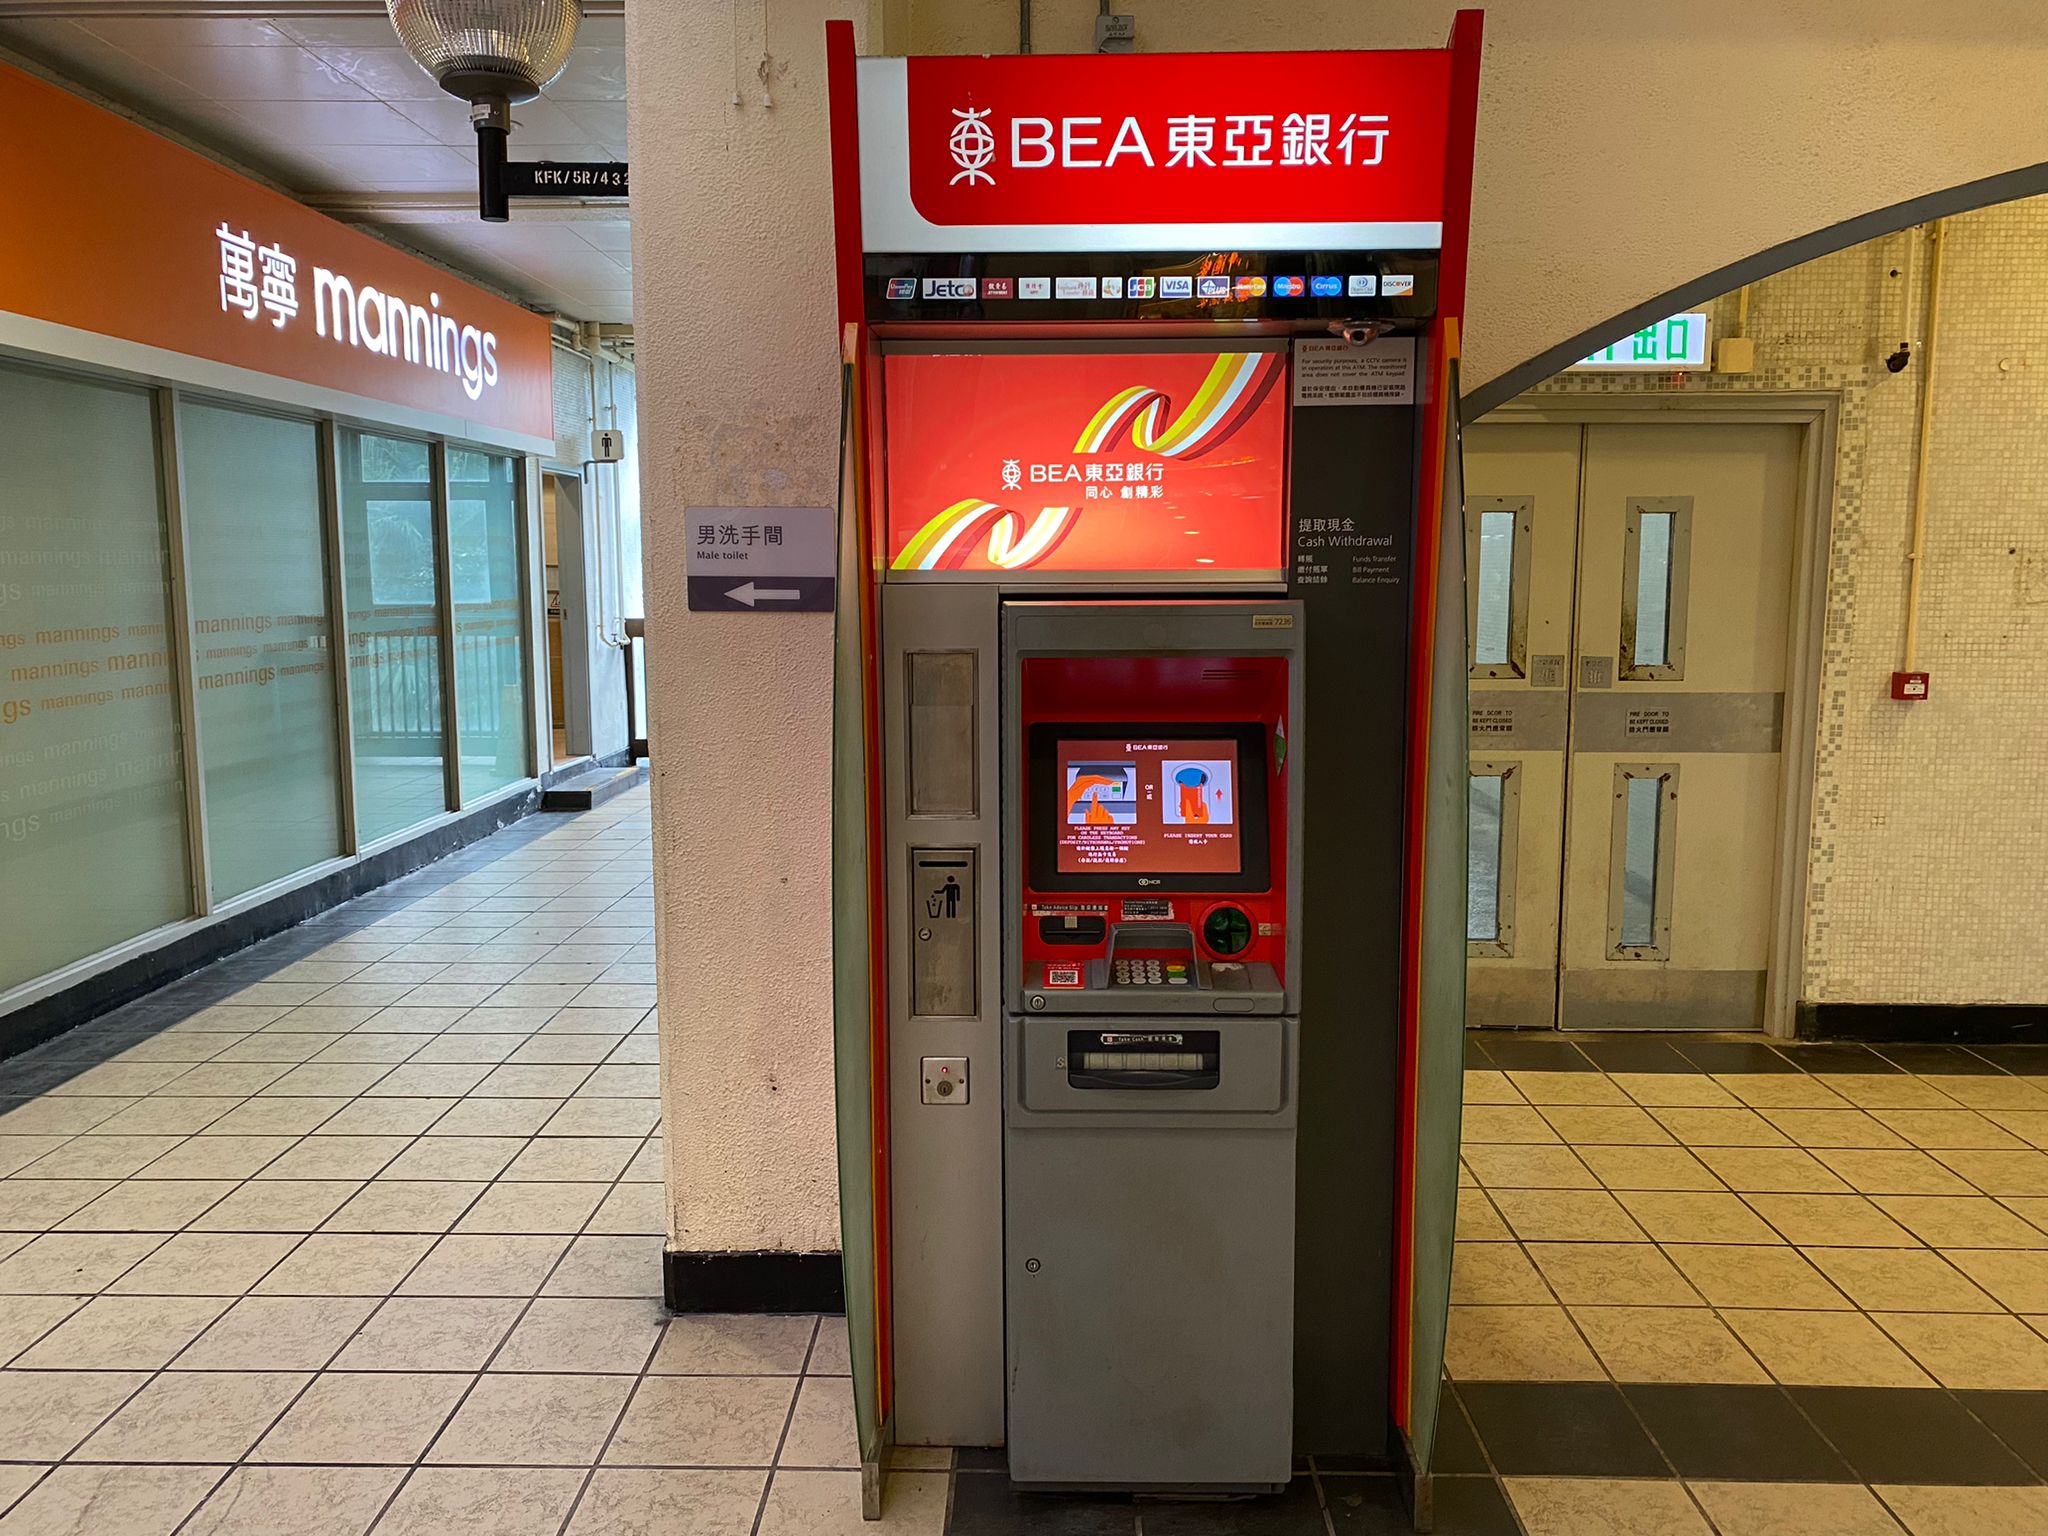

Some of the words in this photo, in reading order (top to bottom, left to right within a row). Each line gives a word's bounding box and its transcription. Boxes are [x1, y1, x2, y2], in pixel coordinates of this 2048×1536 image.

[1010, 116, 1155, 169] BEA
[1165, 112, 1390, 169] 東亞銀行
[1166, 281, 1189, 290] VISA
[1315, 282, 1337, 290] Cirrus
[215, 220, 299, 329] 萬寧
[312, 265, 498, 401] mannings
[1633, 319, 1689, 361] 出口
[1030, 464, 1083, 483] BEA
[1085, 463, 1165, 482] 東亞銀行
[1085, 486, 1113, 500] 同心
[1120, 485, 1164, 499] 創精彩
[696, 524, 783, 546] 男洗手間
[1298, 517, 1355, 533] 提取現金
[1297, 536, 1325, 548] Cash
[1328, 534, 1393, 547] Withdrawal
[696, 551, 720, 560] Male
[722, 551, 749, 560] toilet
[1363, 566, 1390, 575] Payment
[36, 624, 120, 644] mannings
[195, 613, 272, 634] mannings
[11, 659, 99, 682] mannings
[40, 688, 113, 710] mannings
[199, 663, 275, 690] mannings
